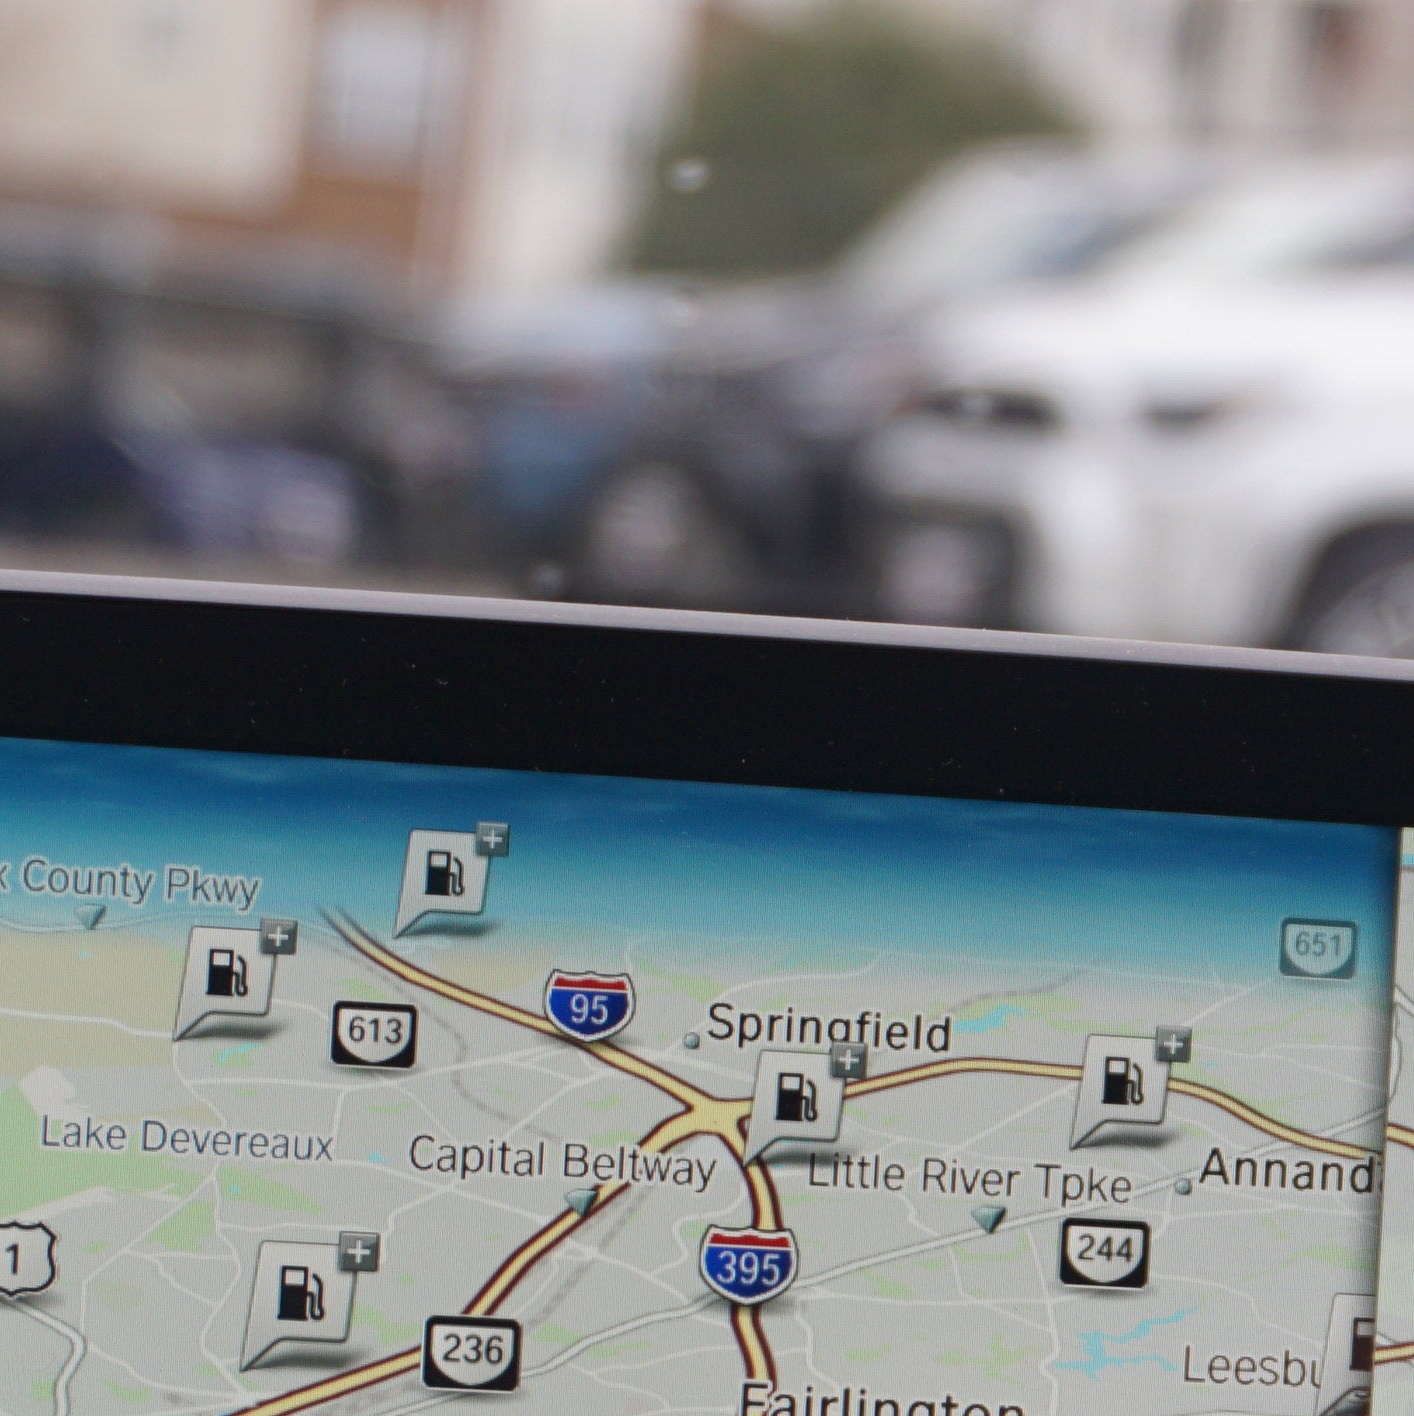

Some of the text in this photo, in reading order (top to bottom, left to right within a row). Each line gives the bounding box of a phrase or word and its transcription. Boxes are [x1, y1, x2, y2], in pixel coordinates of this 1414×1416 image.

[24, 859, 152, 904] County
[168, 868, 260, 911] Pkwy
[1295, 933, 1342, 959] 651
[569, 995, 609, 1026] 95
[707, 1003, 951, 1052] Springfield
[348, 1017, 403, 1045] 613
[42, 1115, 333, 1162] Lake Devereaux
[410, 1135, 717, 1193] Capital Beltway
[808, 1153, 1133, 1209] Little River Tpke
[1199, 1147, 1382, 1193] Annand
[5, 1245, 21, 1277] 1
[1077, 1236, 1134, 1263] 244
[717, 1250, 781, 1286] 395
[442, 1335, 504, 1366] 236
